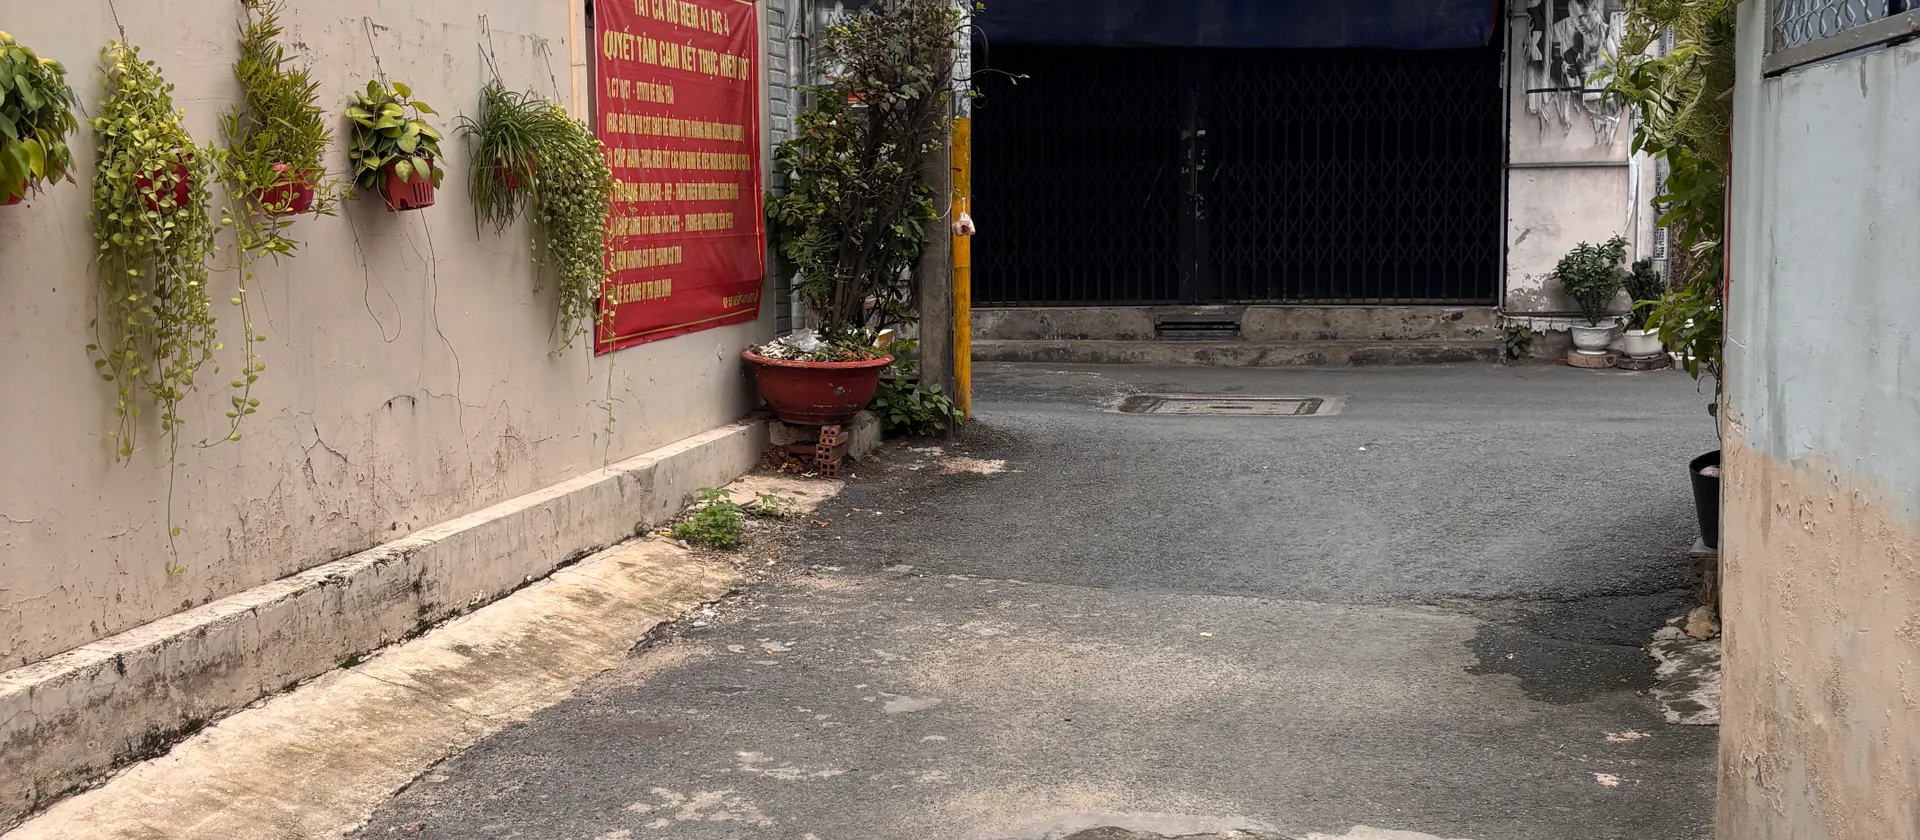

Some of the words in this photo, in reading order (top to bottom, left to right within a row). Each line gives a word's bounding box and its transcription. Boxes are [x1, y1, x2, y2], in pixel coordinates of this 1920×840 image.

[701, 7, 710, 32] 41
[724, 13, 730, 36] 4
[604, 25, 635, 60] QUYẾT
[636, 31, 658, 65] TÂM
[660, 40, 680, 69] CAM
[681, 39, 696, 72] KẾT
[698, 49, 718, 80] THỰC
[720, 50, 737, 83] HIỆN
[738, 50, 750, 81] TỐT
